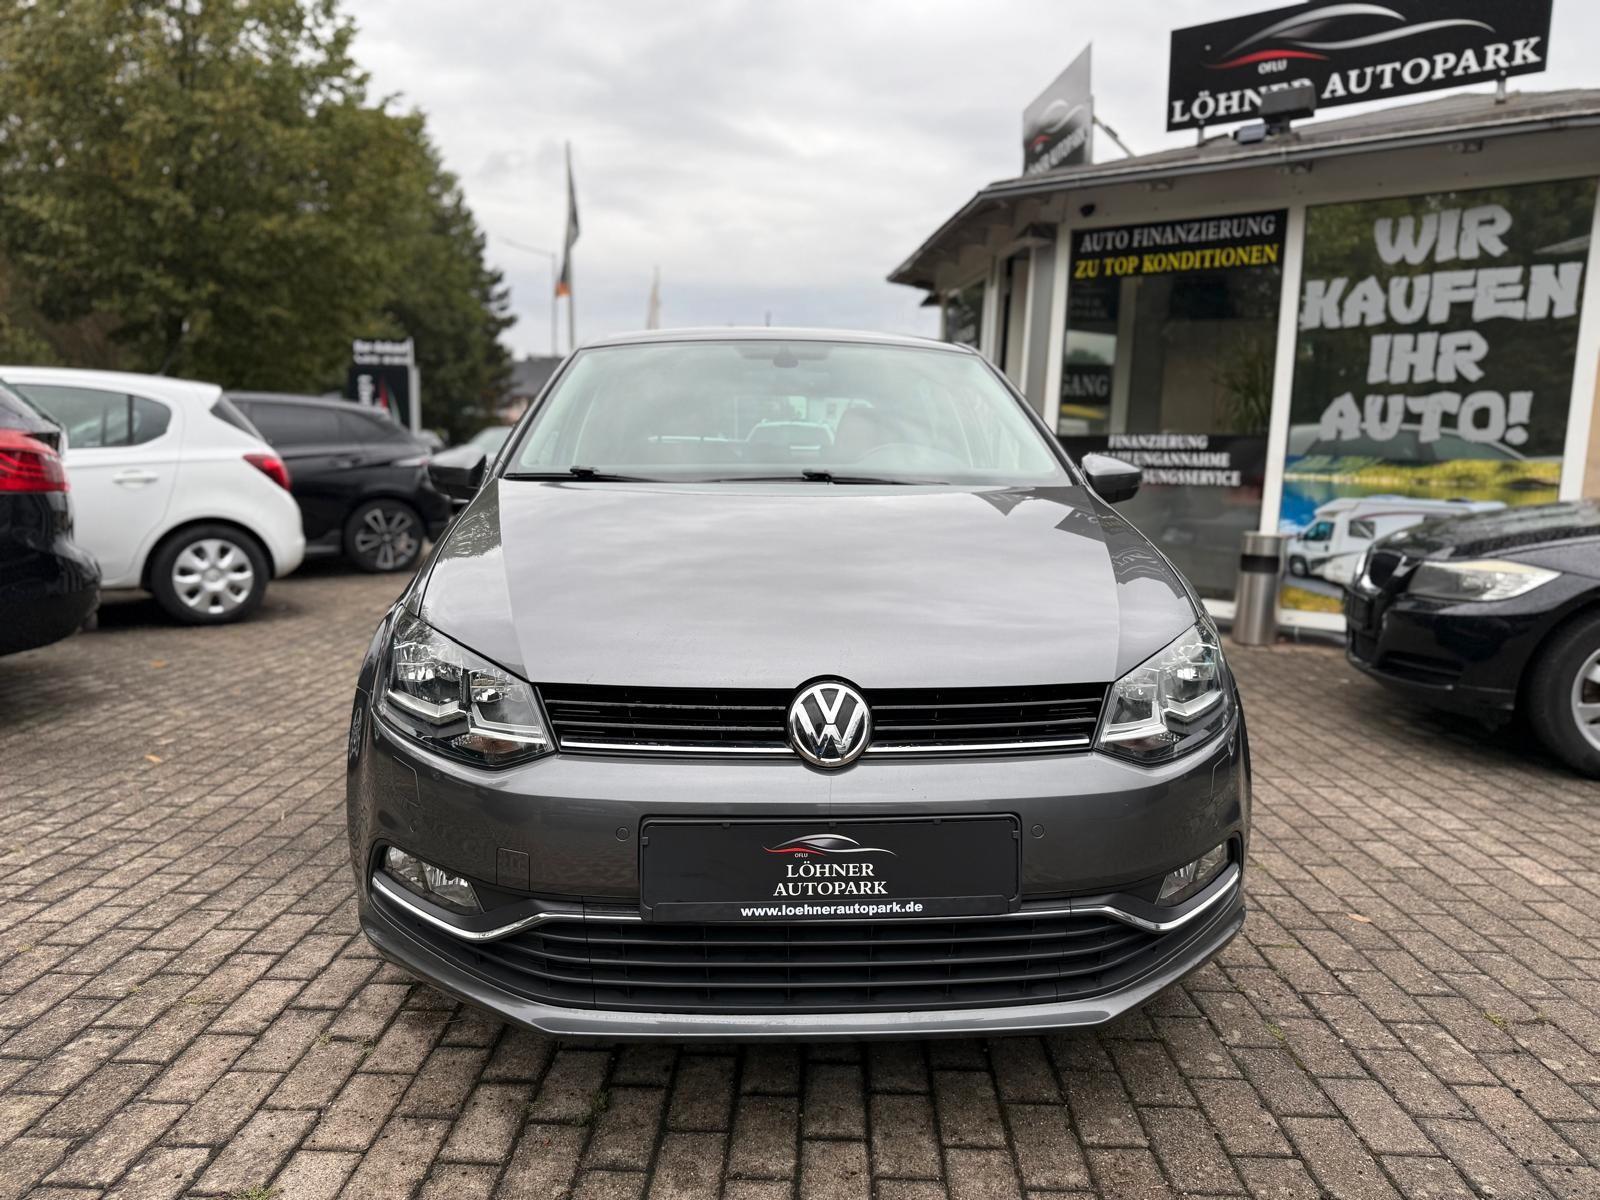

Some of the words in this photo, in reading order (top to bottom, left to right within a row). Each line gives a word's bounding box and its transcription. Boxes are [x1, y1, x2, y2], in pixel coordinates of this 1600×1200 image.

[1171, 78, 1314, 123] LÖHN
[1320, 36, 1543, 99] AUTOPARK
[1080, 230, 1129, 253] AUTO
[1132, 215, 1276, 248] FINANZIERUNG
[1374, 204, 1512, 265] WIR
[1074, 259, 1099, 279] ZU
[1103, 256, 1139, 276] TOP
[1141, 244, 1279, 273] KONDITIONEN
[1300, 262, 1583, 330] KAUFEN
[1366, 330, 1489, 384] IHR
[1319, 390, 1534, 445] AUTO!
[1107, 434, 1209, 449] FINANZIERUNG
[786, 860, 875, 878] LÖHNER
[772, 881, 889, 896] AUTOPARK
[740, 901, 923, 917] www.loehnerautopark.de
